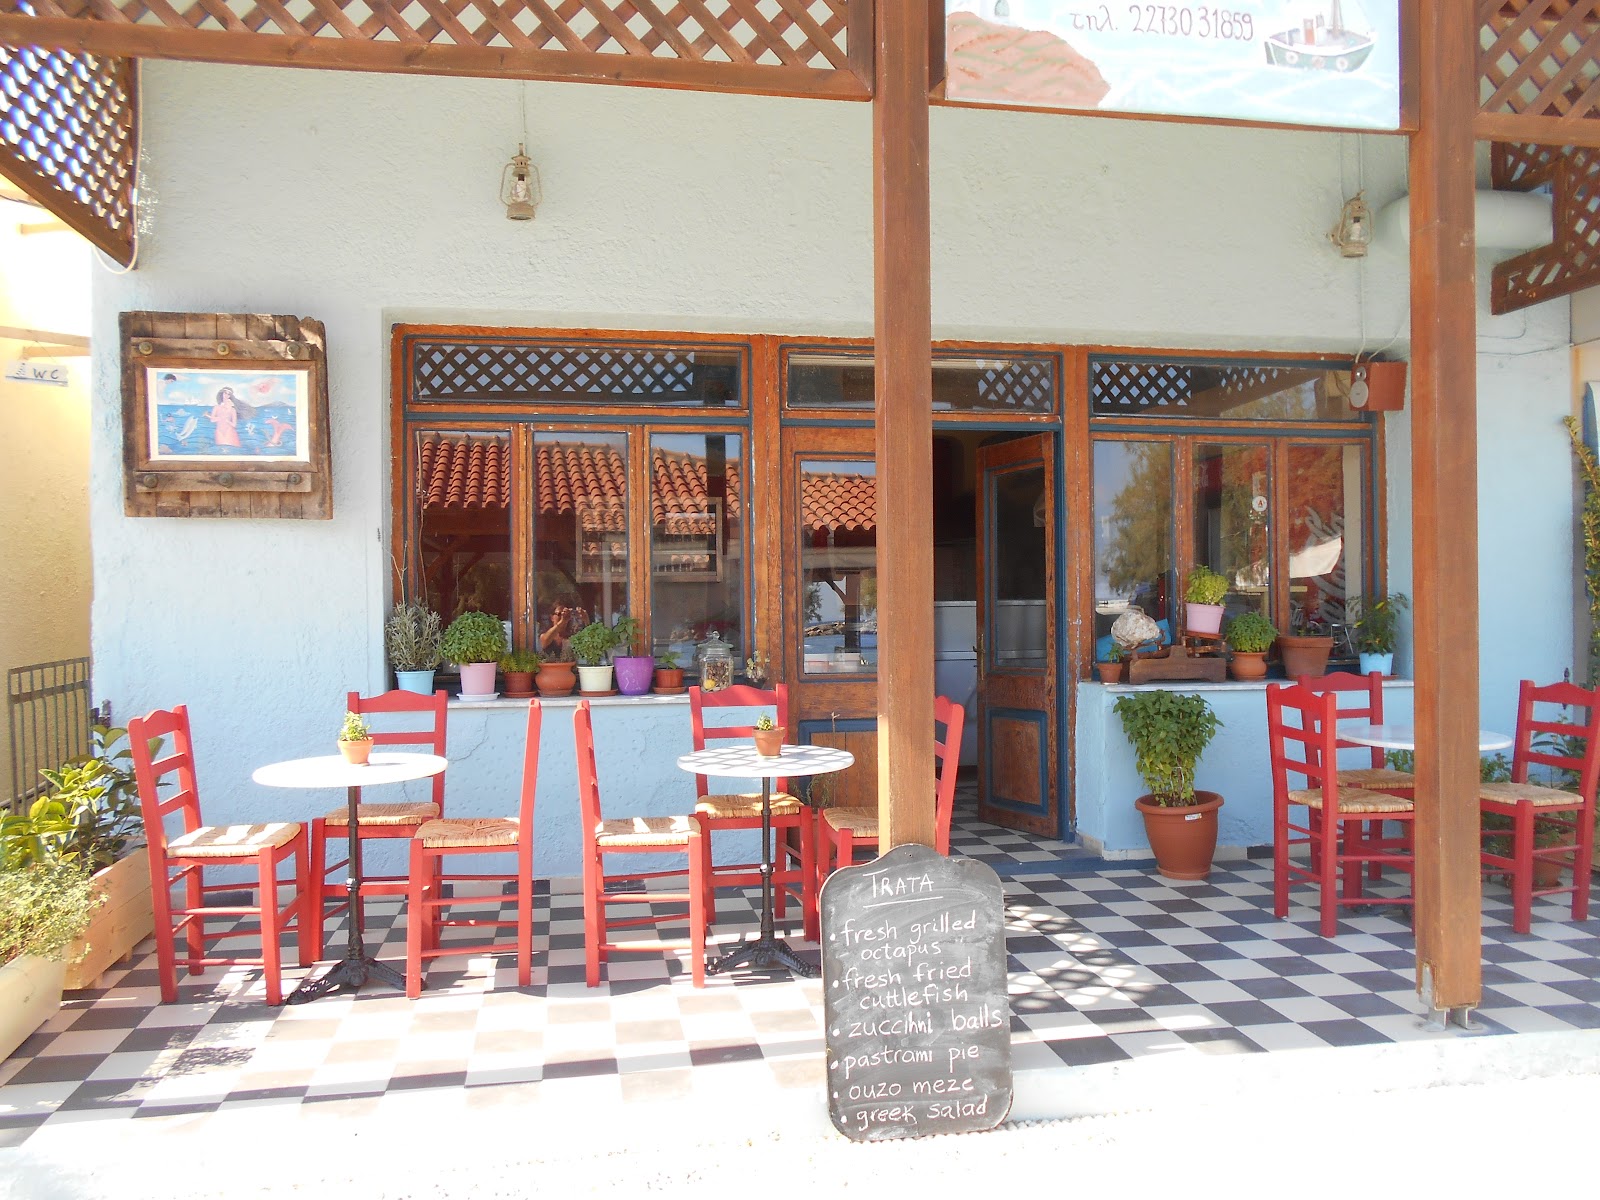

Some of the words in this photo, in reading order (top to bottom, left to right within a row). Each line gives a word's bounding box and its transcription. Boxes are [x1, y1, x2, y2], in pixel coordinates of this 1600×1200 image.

[1129, 5, 1192, 36] 22730
[1198, 6, 1254, 41] 31859
[863, 868, 934, 898] TRATA
[841, 919, 897, 946] fresh
[910, 909, 977, 944] grilled
[860, 940, 942, 967] octapus
[842, 967, 901, 991] fresh
[916, 956, 972, 984] fried
[859, 983, 969, 1010] cuttlefish
[951, 1004, 1003, 1031] balls
[844, 1046, 933, 1080] pastrami
[948, 1042, 980, 1073] pie
[849, 1082, 902, 1100] ouzo
[913, 1074, 975, 1095] meze
[856, 1104, 917, 1131] greek
[926, 1094, 989, 1119] salad
